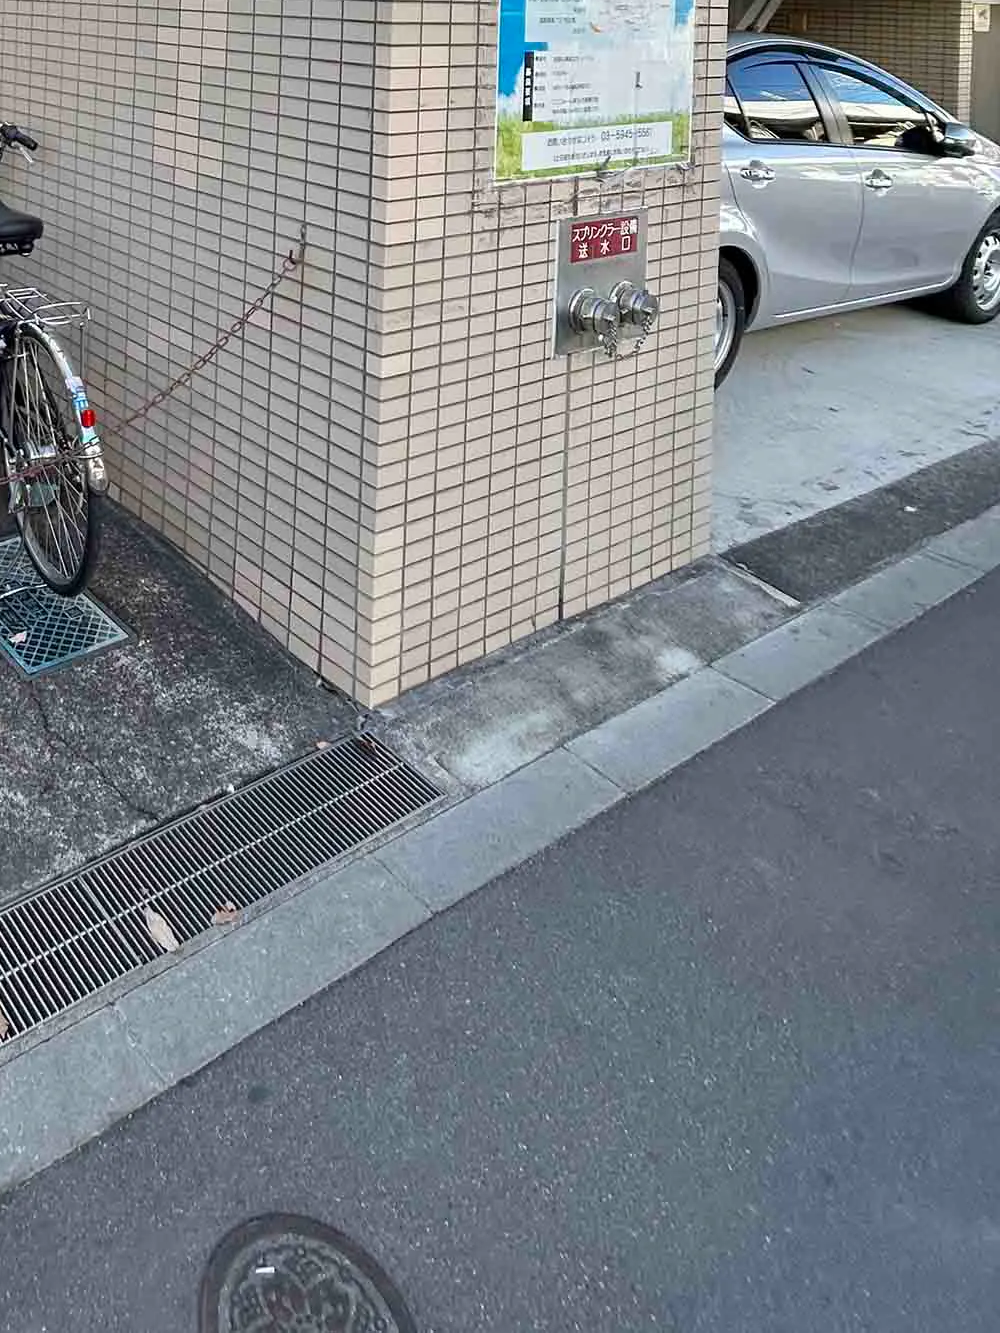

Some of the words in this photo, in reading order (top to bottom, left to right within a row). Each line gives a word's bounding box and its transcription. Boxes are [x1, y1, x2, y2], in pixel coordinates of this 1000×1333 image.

[572, 219, 638, 242] スプリンクラー設備
